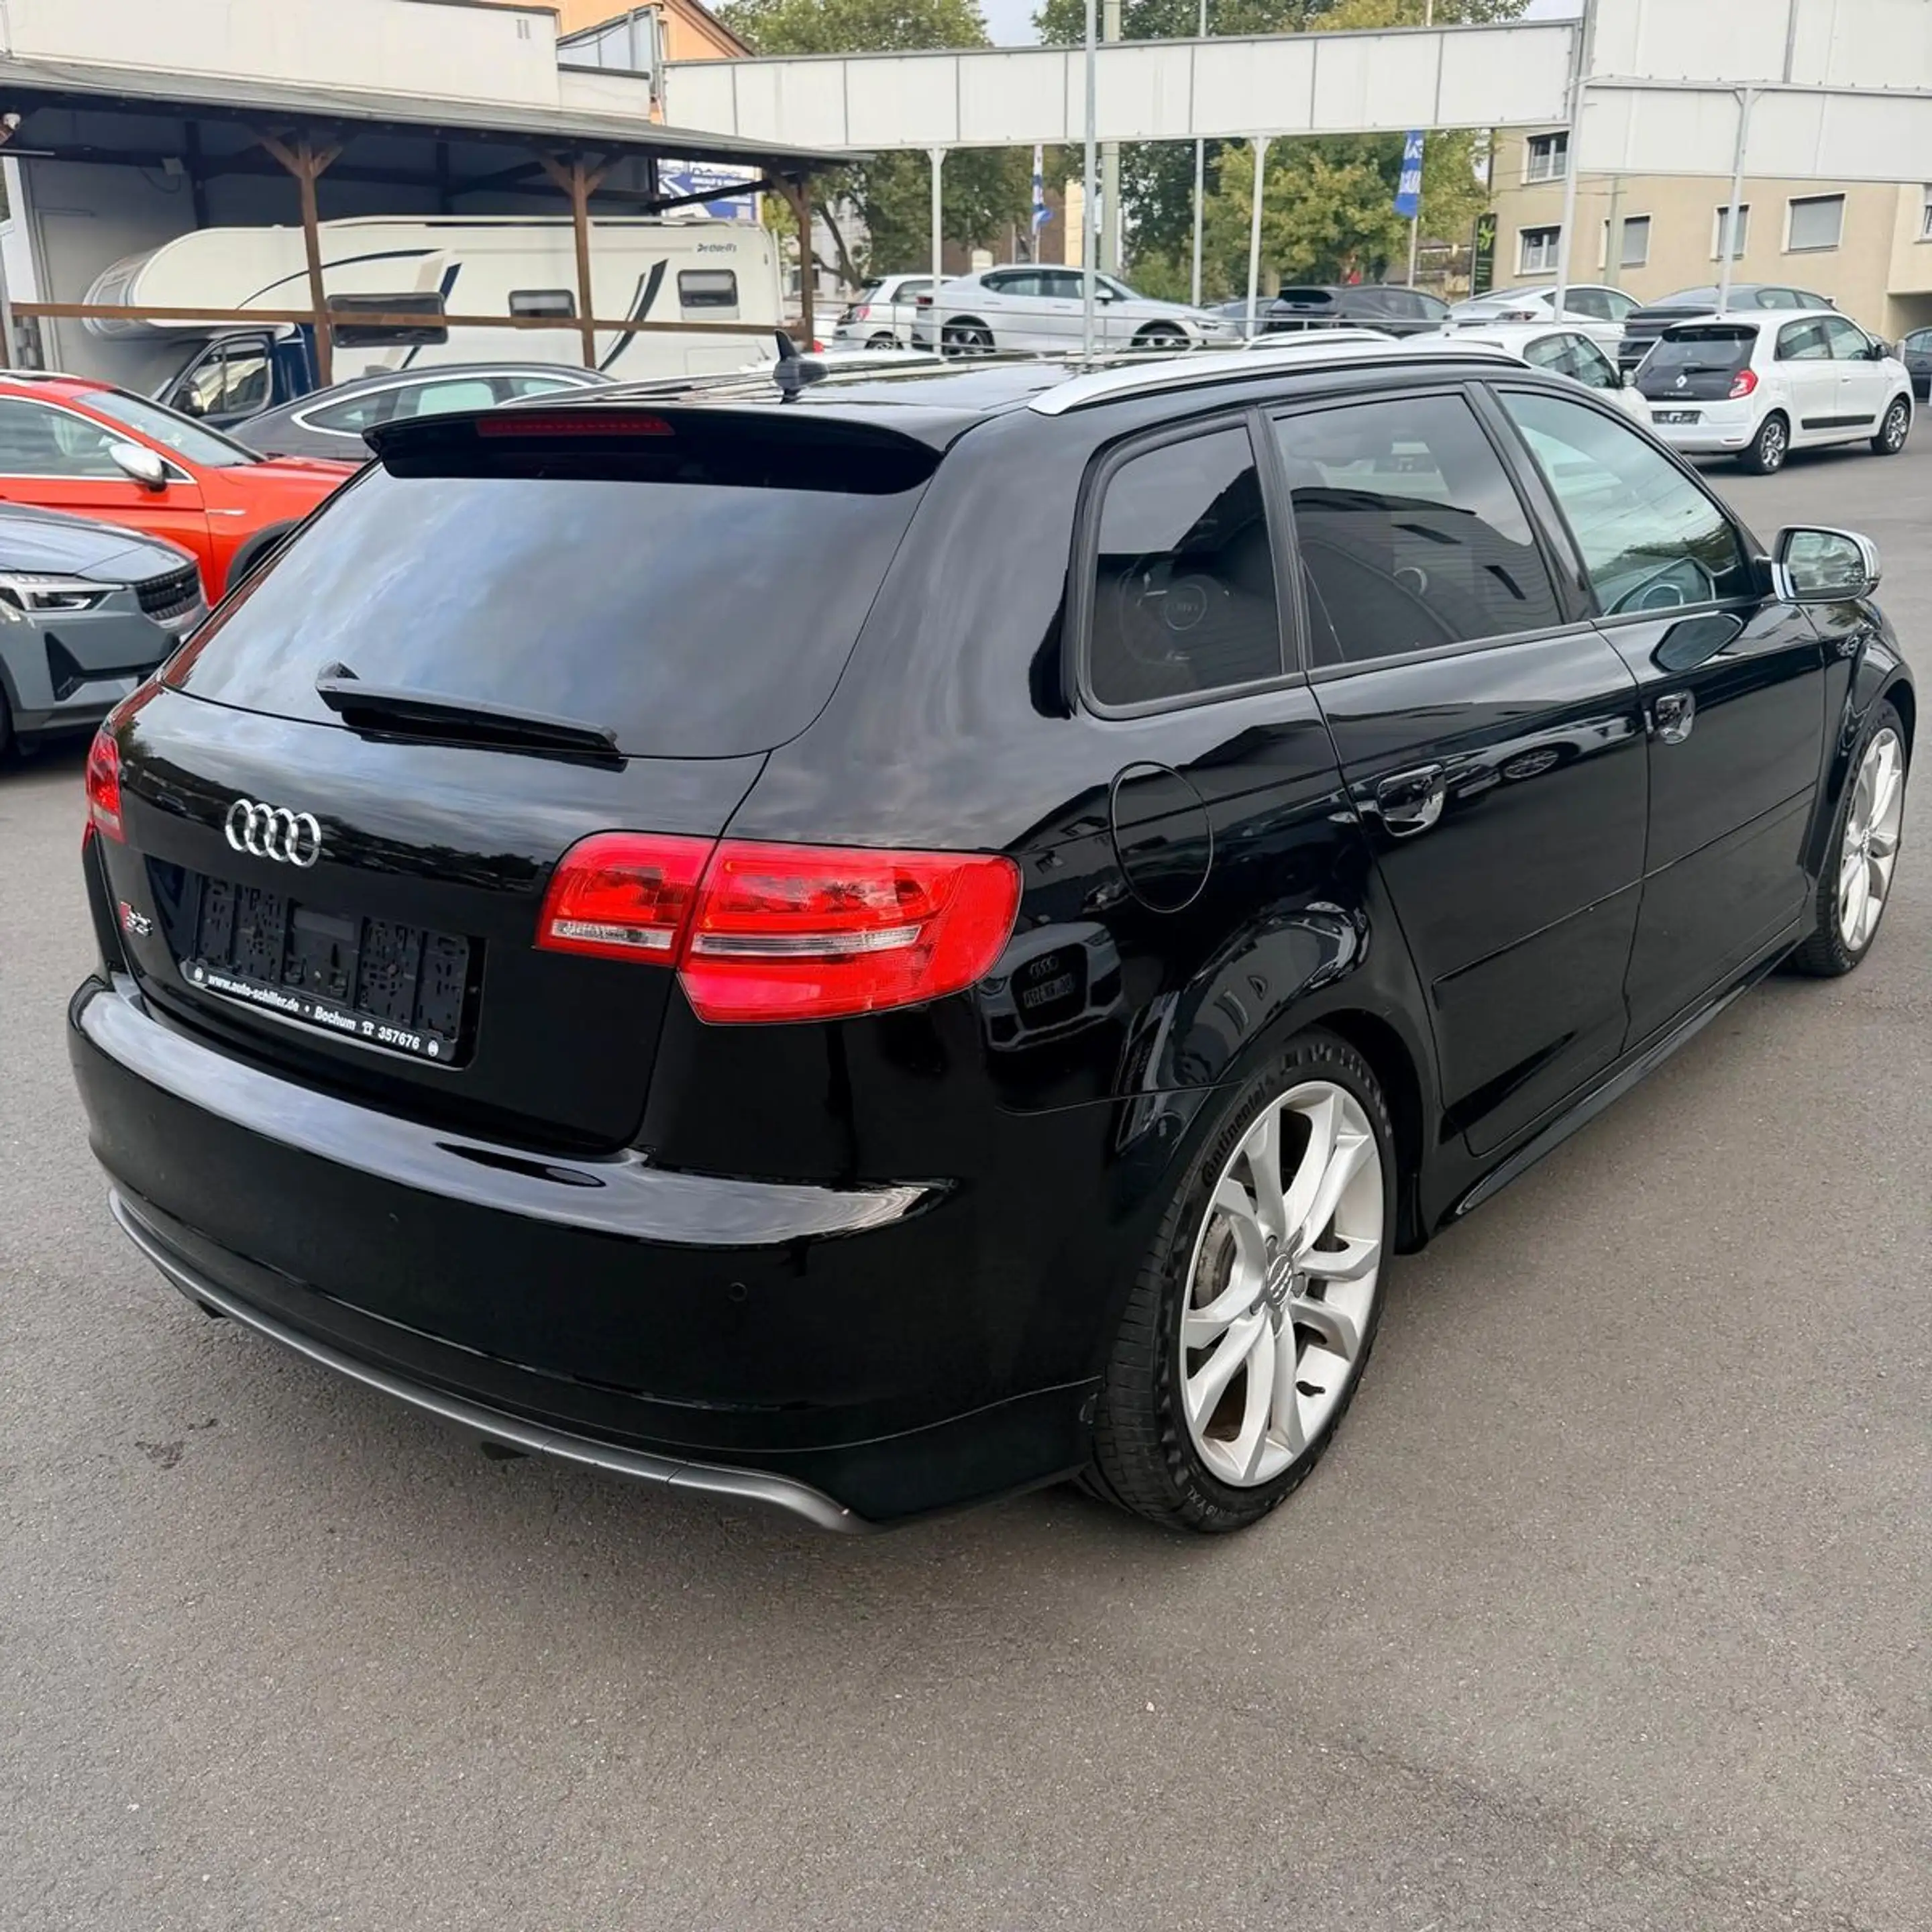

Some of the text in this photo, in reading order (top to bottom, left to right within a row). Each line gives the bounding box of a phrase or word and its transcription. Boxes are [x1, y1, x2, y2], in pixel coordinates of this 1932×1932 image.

[314, 1006, 357, 1031] Bochum
[378, 1026, 421, 1051] 357676
[1201, 1083, 1267, 1187] Continental
